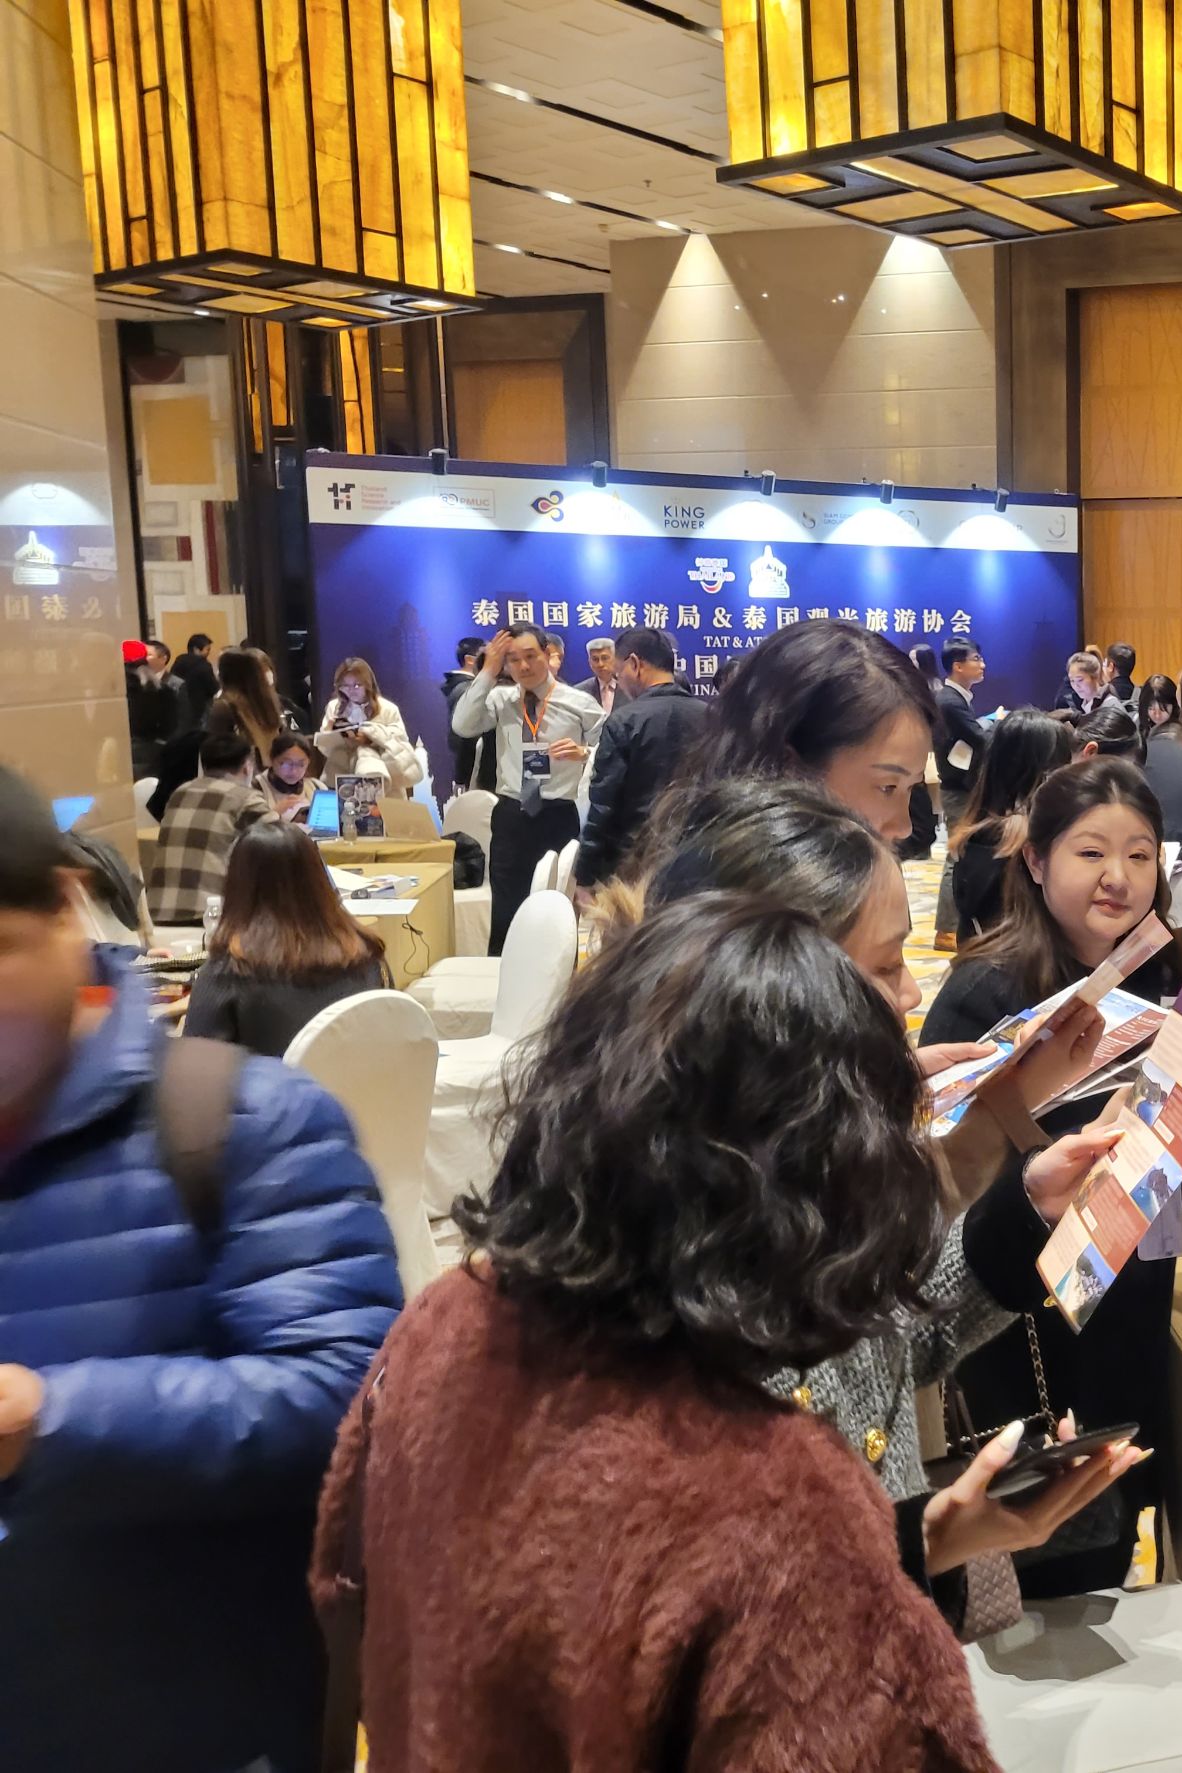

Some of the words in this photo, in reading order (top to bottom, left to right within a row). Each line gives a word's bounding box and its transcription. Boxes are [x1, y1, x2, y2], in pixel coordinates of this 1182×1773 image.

[663, 504, 705, 519] KING
[663, 519, 705, 530] POWER
[471, 598, 701, 630] 泰国国家旅游局
[712, 606, 733, 629] &
[703, 635, 731, 648] TAT
[732, 637, 743, 649] &
[745, 636, 766, 649] AT
[689, 684, 720, 697] INA
